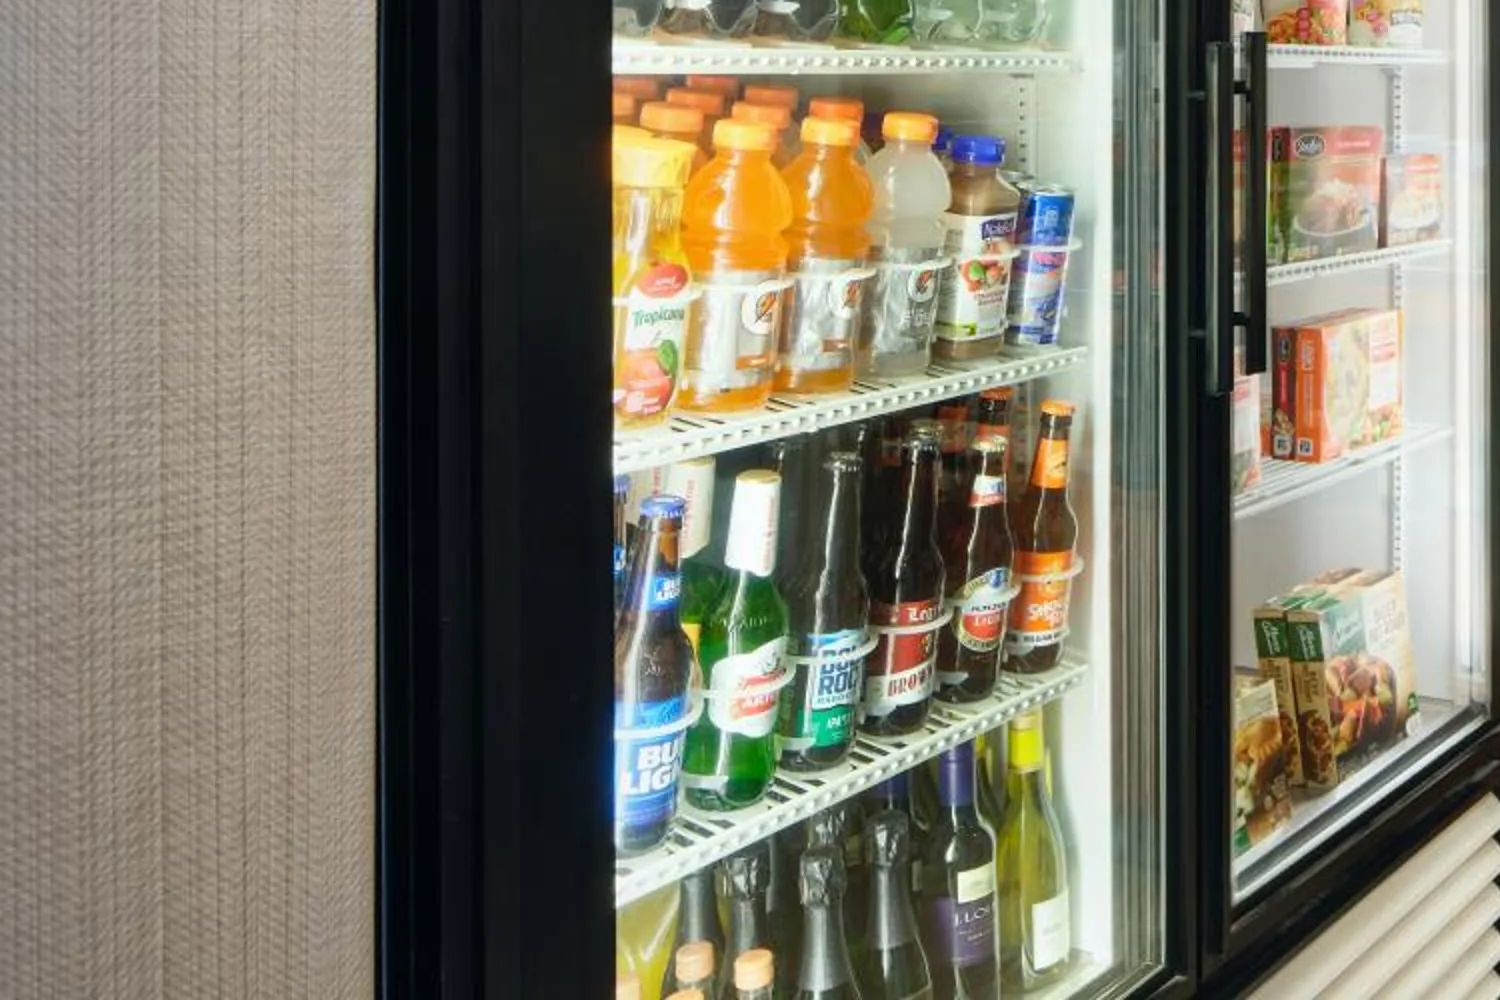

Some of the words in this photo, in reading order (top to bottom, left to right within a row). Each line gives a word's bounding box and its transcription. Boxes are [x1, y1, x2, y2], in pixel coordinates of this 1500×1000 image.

[818, 672, 858, 695] ROC
[637, 743, 680, 769] BU
[621, 769, 679, 797] LIG
